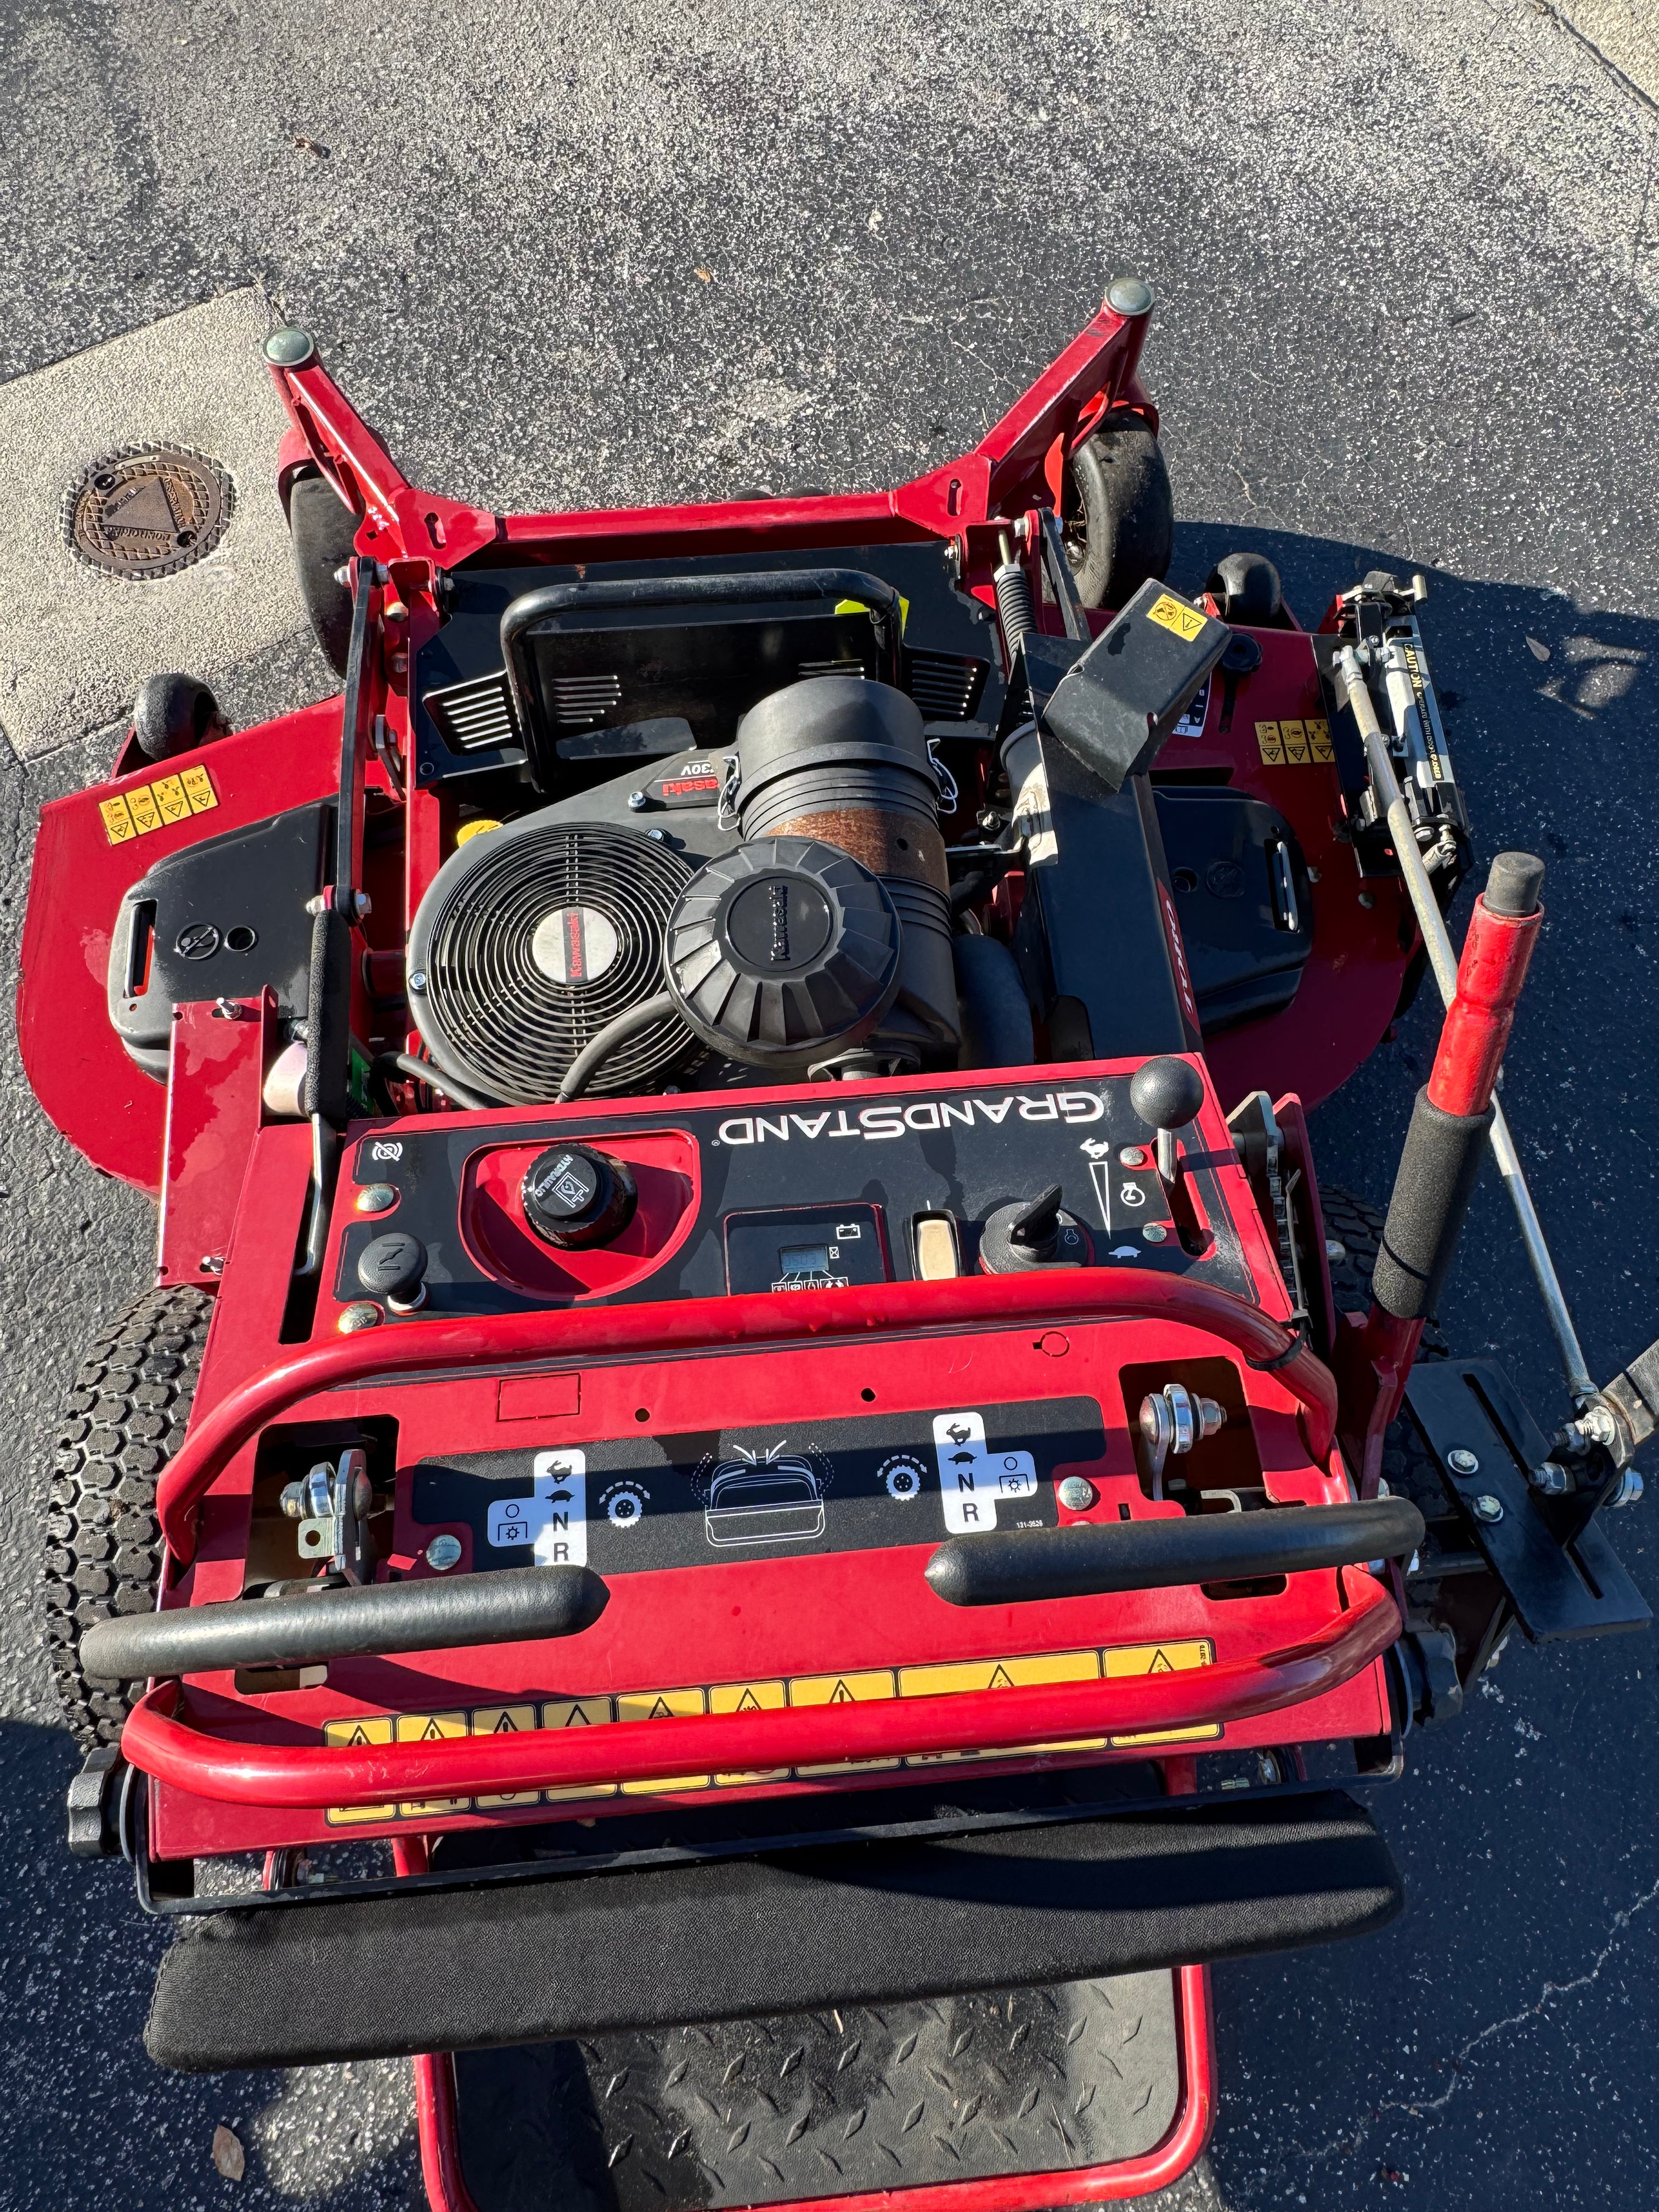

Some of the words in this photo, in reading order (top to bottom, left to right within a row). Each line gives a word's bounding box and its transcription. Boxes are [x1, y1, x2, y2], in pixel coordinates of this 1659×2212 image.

[1404, 644, 1423, 687] CAUTION
[681, 763, 714, 776] 30V
[662, 779, 718, 797] asaki
[958, 1473, 975, 1492] N
[552, 1511, 568, 1531] N
[963, 1503, 979, 1522] R
[554, 1542, 568, 1562] R
